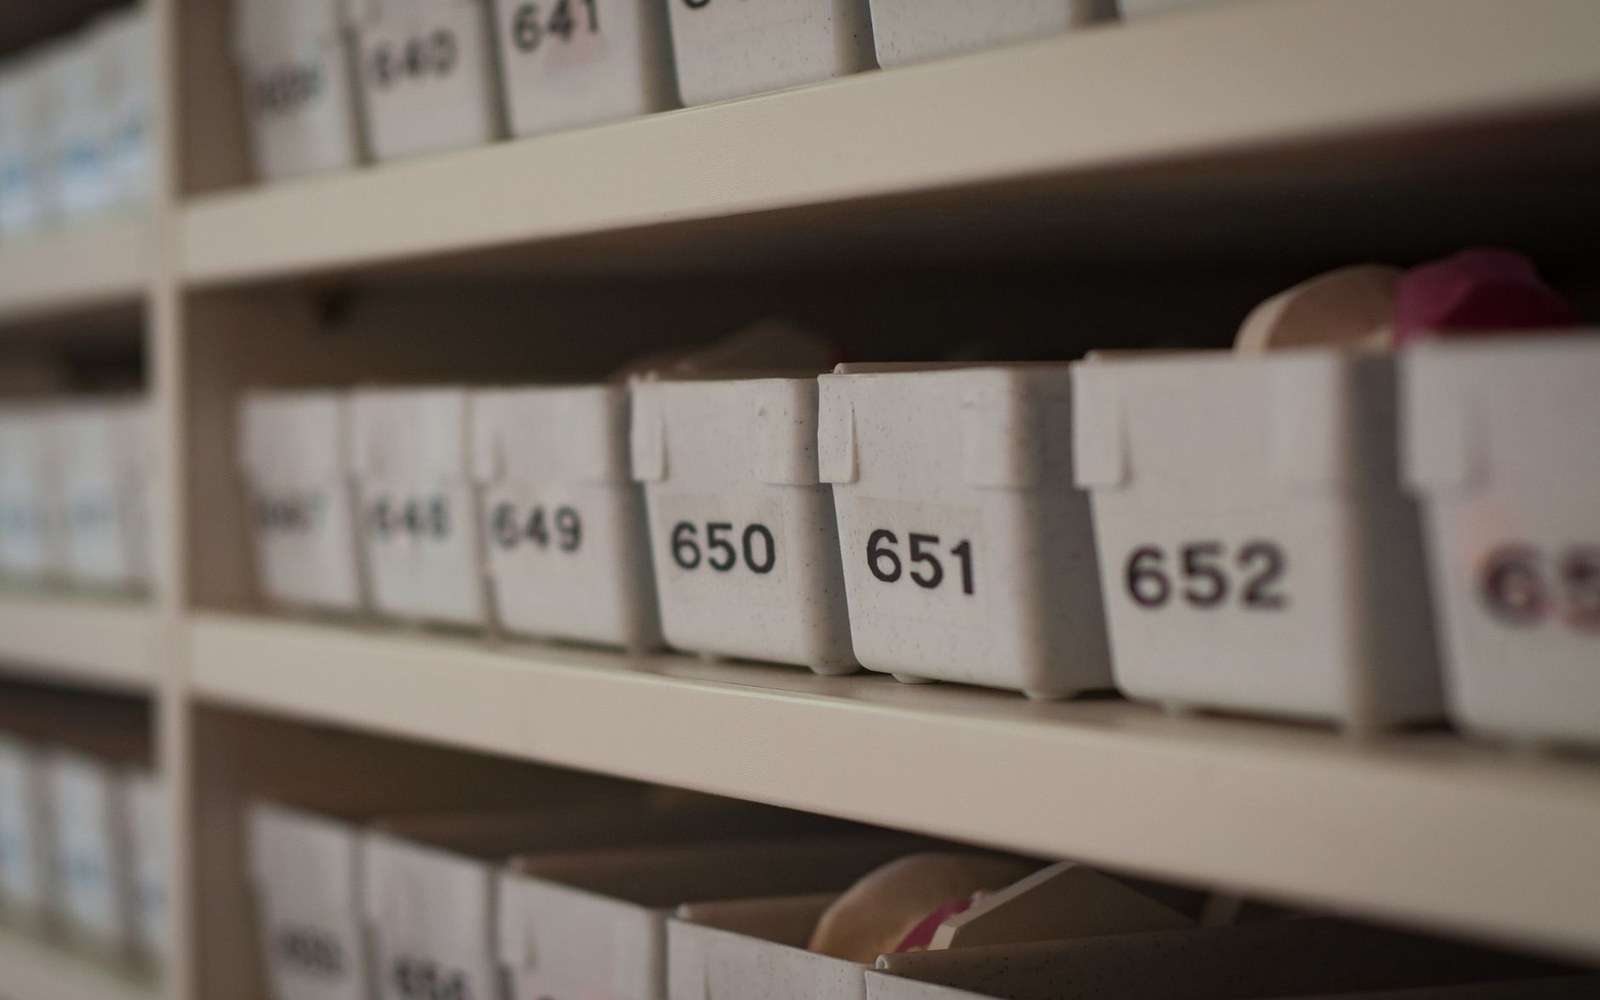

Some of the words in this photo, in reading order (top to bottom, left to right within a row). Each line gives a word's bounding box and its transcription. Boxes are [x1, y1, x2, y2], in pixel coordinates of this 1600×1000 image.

[511, 0, 600, 52] 641
[491, 502, 583, 553] 649
[670, 522, 776, 575] 650
[866, 528, 976, 596] 651
[1124, 541, 1289, 610] 652
